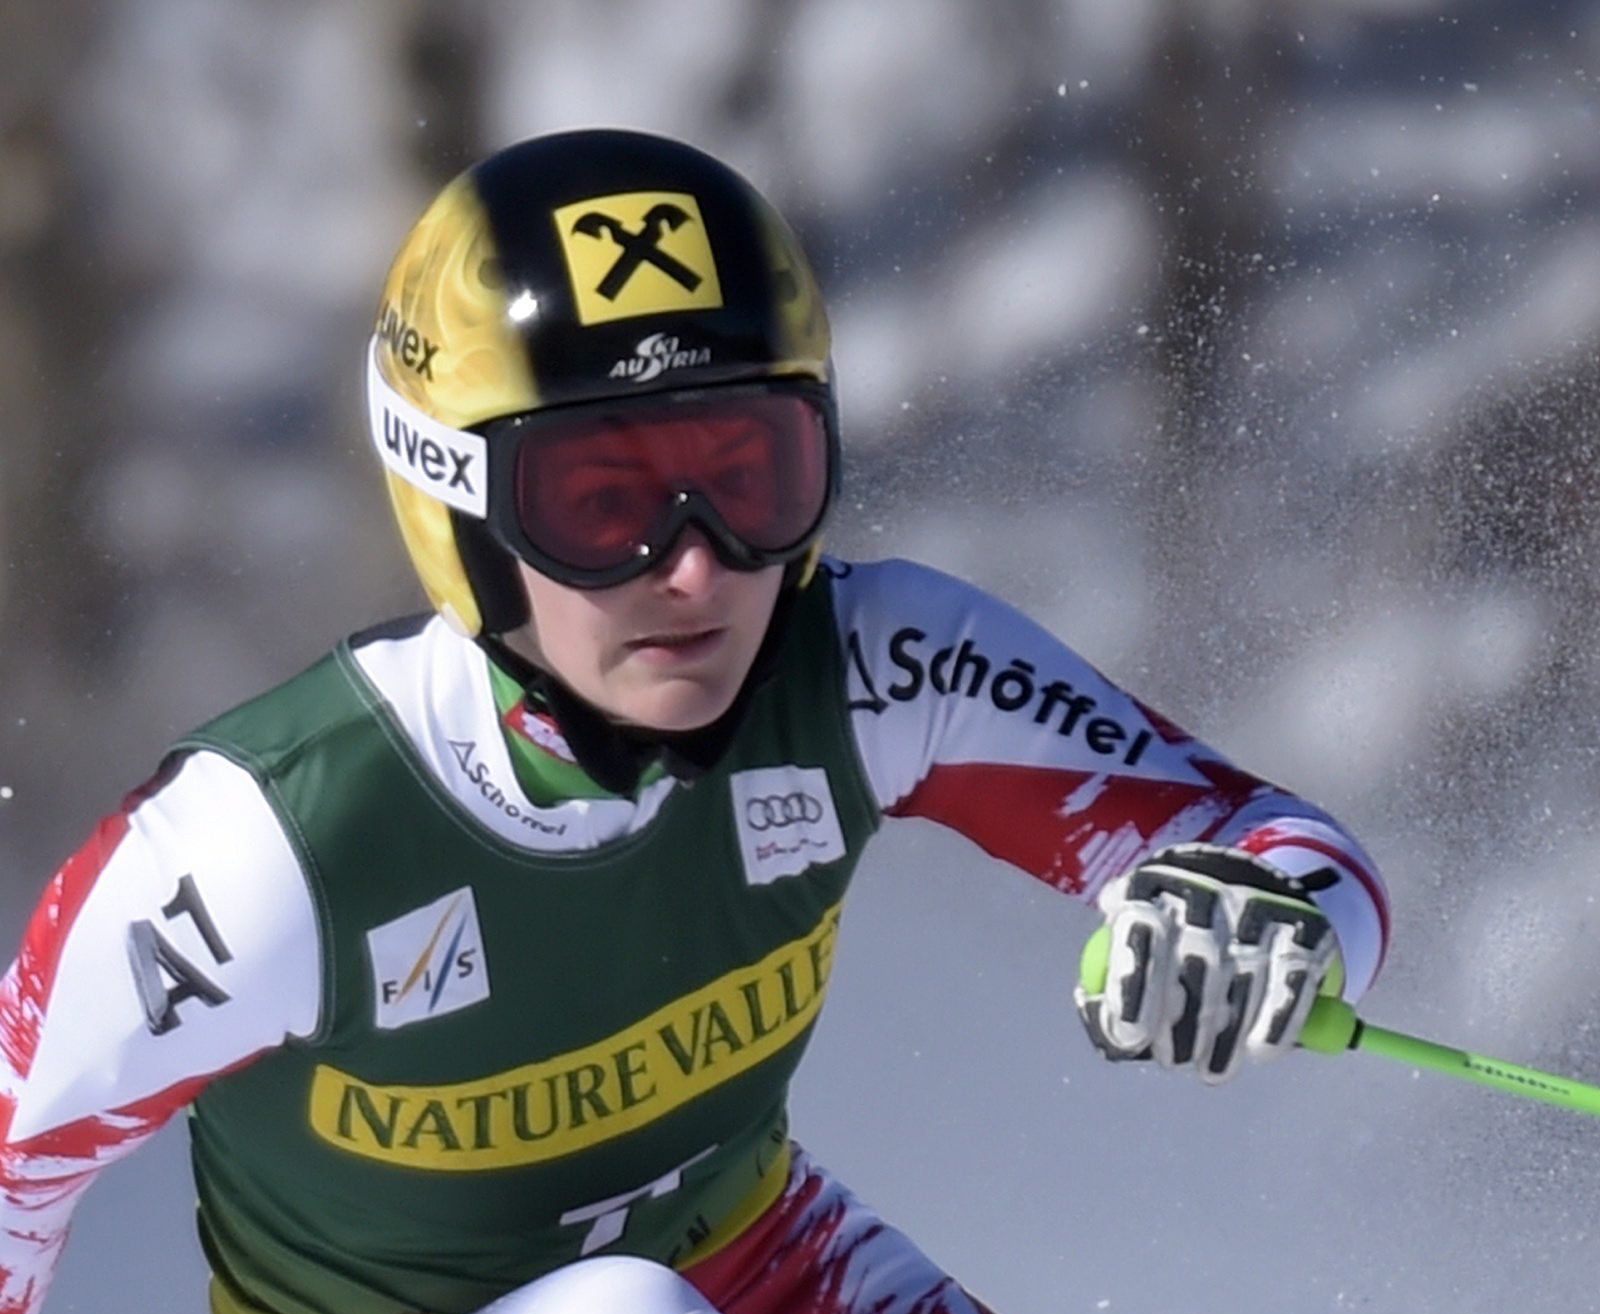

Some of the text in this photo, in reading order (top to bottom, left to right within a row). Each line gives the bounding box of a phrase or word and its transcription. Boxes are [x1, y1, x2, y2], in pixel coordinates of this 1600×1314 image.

[380, 301, 439, 382] uvex
[608, 346, 712, 383] AUSTRIA
[383, 406, 475, 495] uvex
[887, 626, 1153, 766] Schöffel
[127, 872, 234, 1036] A1
[382, 949, 477, 1004] FIS
[335, 912, 841, 1152] NATURE VALLE
